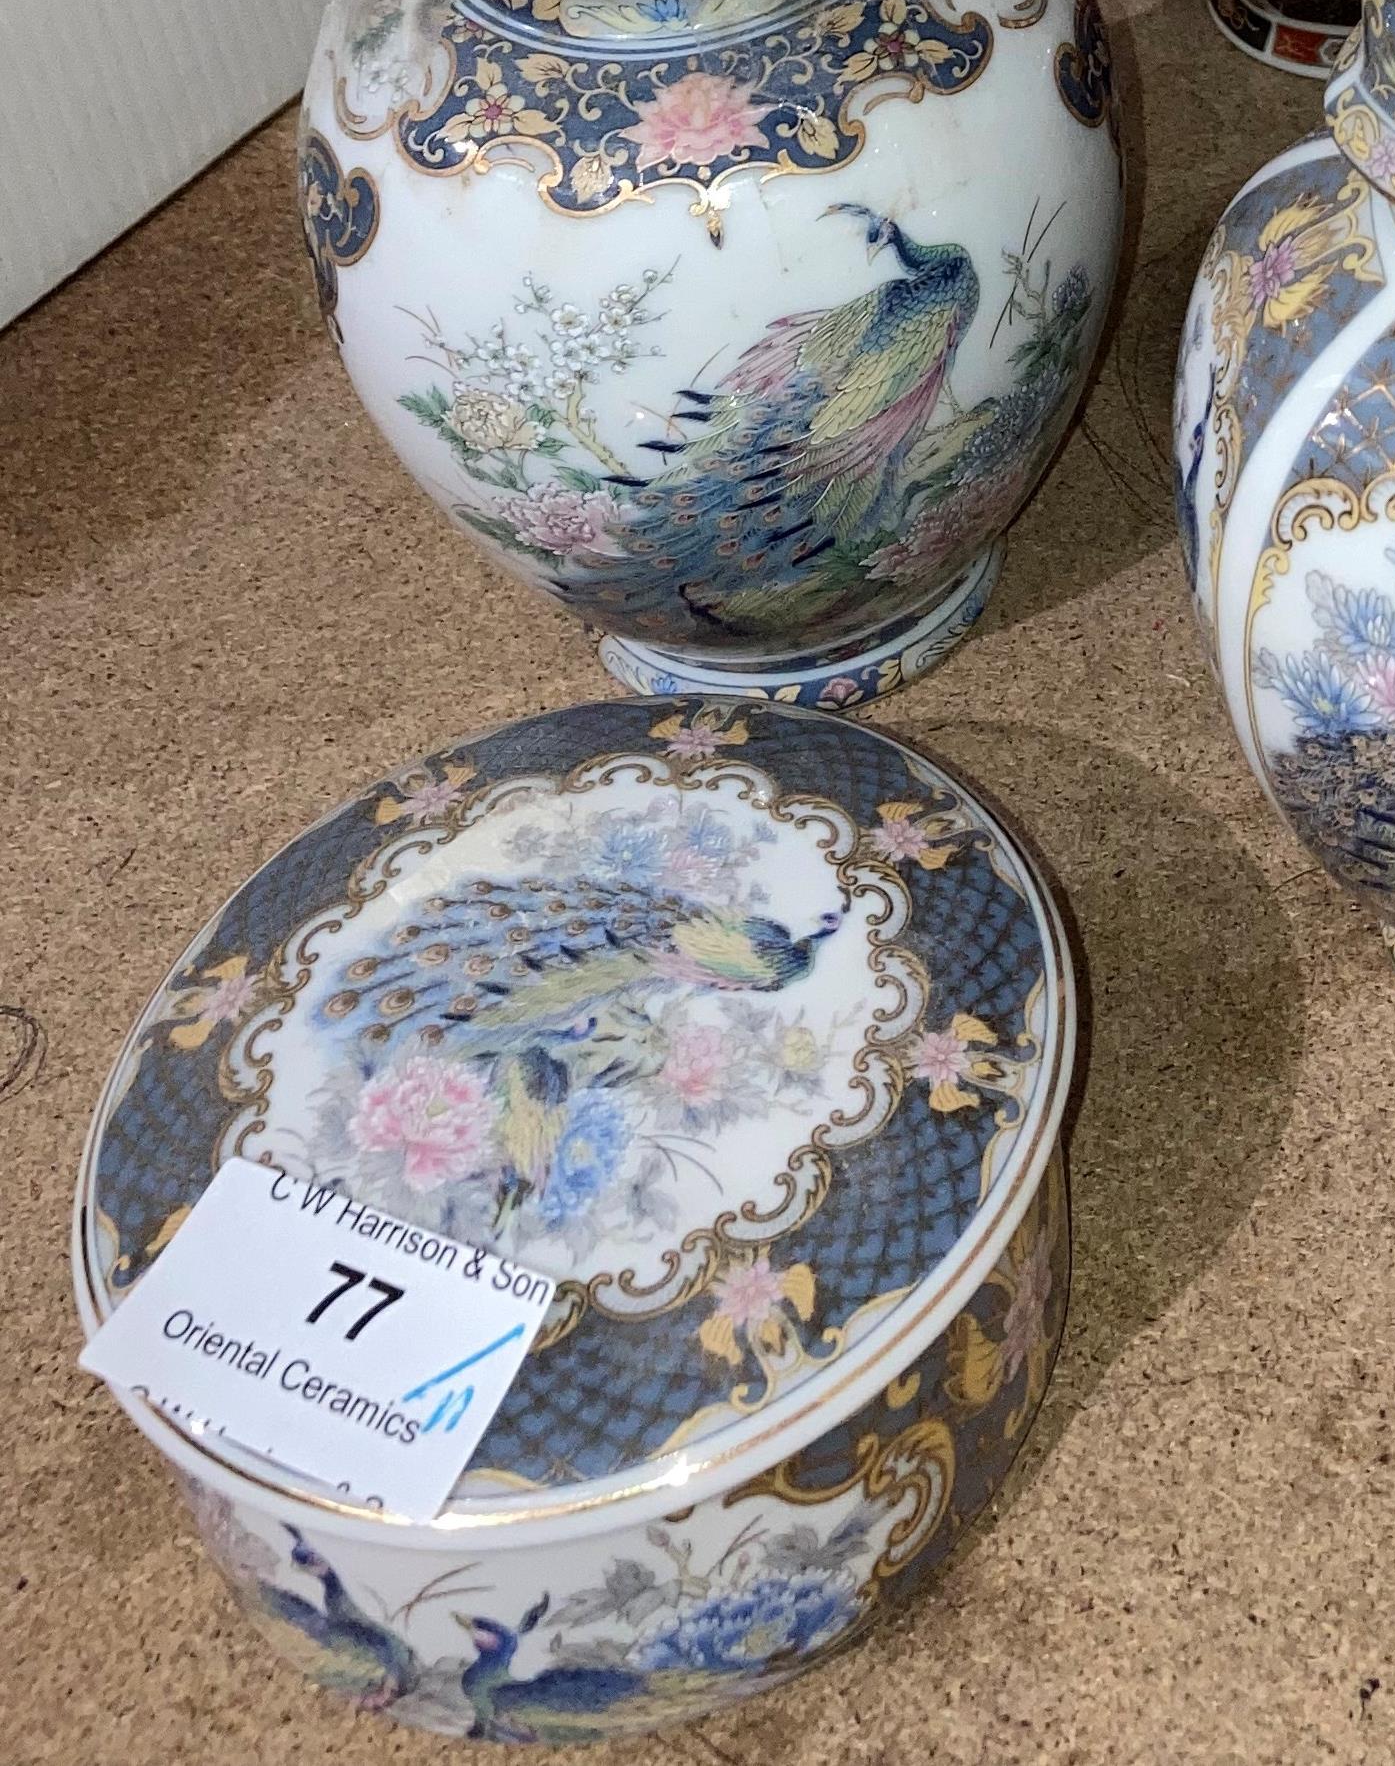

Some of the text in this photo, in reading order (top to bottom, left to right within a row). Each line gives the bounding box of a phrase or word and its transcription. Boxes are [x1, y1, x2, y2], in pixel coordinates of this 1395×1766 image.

[270, 1170, 550, 1307] C W Harrison & Son
[305, 1260, 406, 1341] 77
[163, 1309, 420, 1444] Oriental Ceramics
